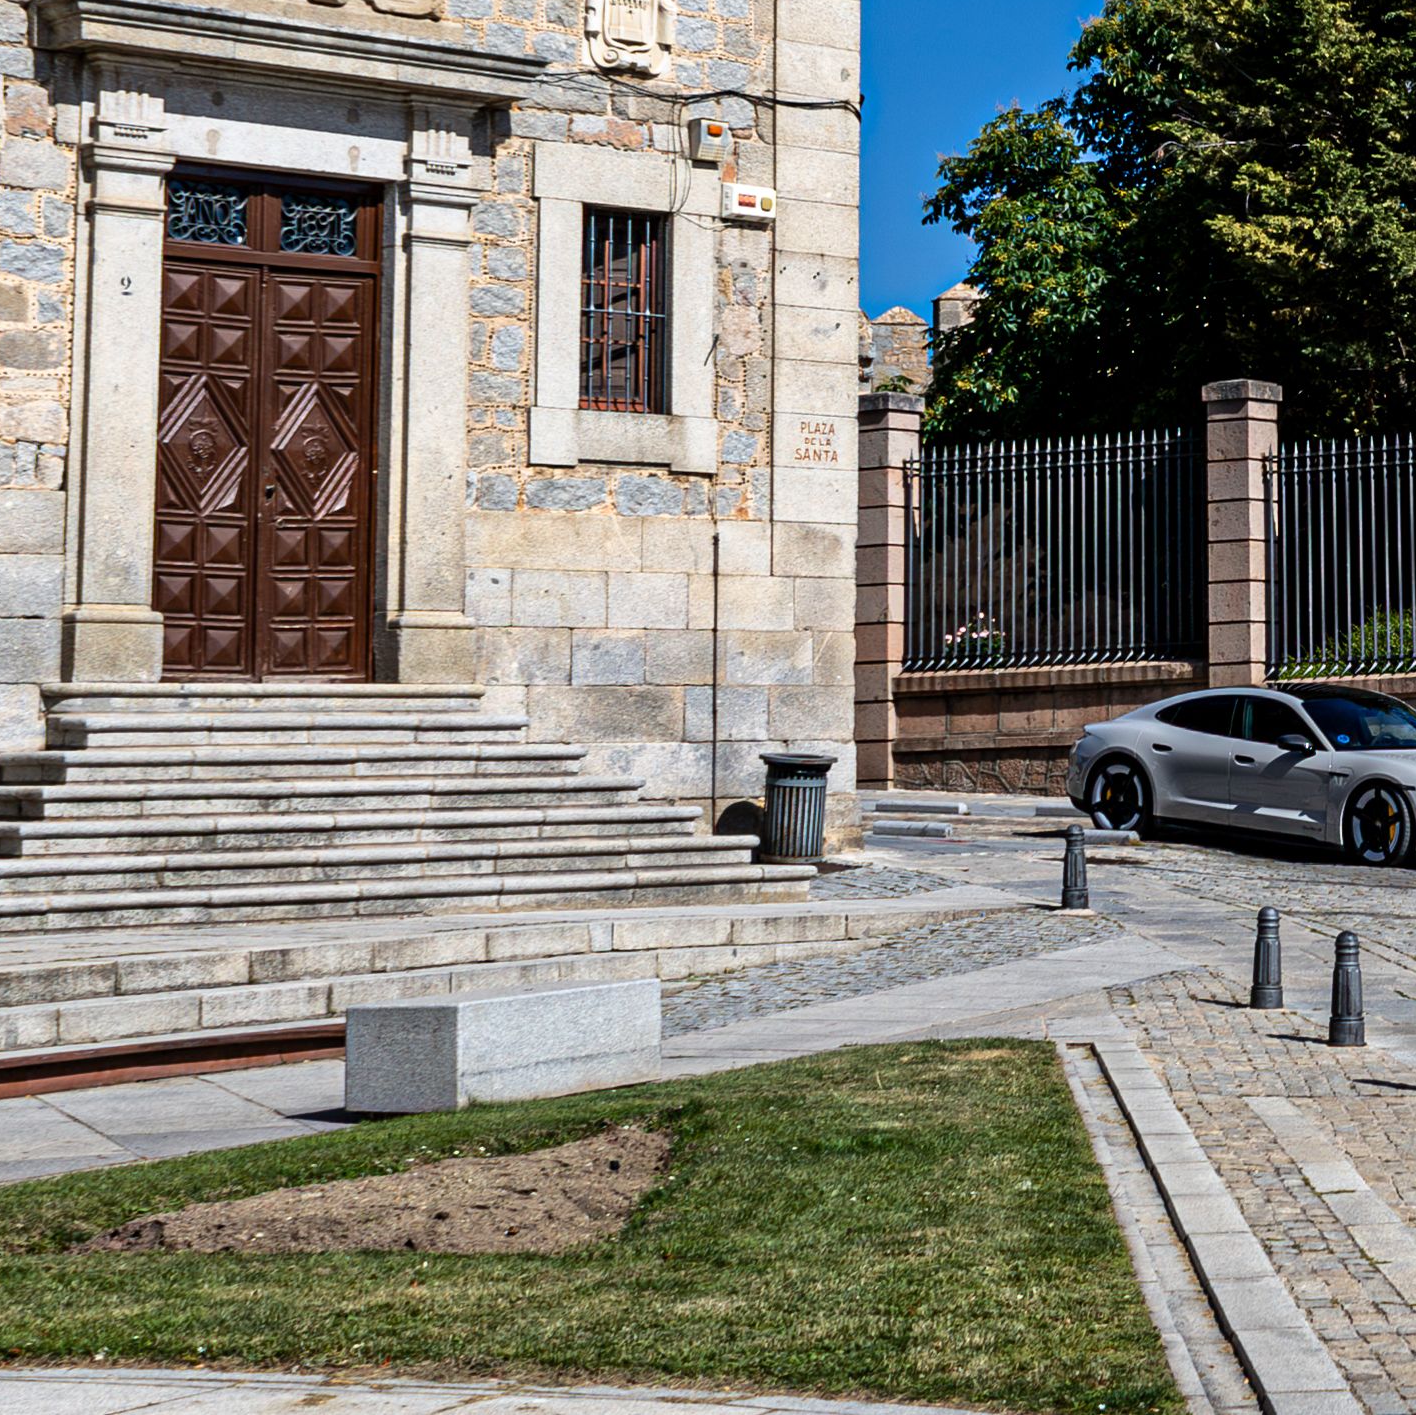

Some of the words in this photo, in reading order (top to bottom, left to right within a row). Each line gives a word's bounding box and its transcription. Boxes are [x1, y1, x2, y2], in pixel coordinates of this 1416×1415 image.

[295, 212, 338, 237] 1891
[800, 421, 835, 435] PLAZA
[804, 437, 816, 445] DE
[819, 438, 831, 446] LA
[794, 447, 838, 462] SANTA
